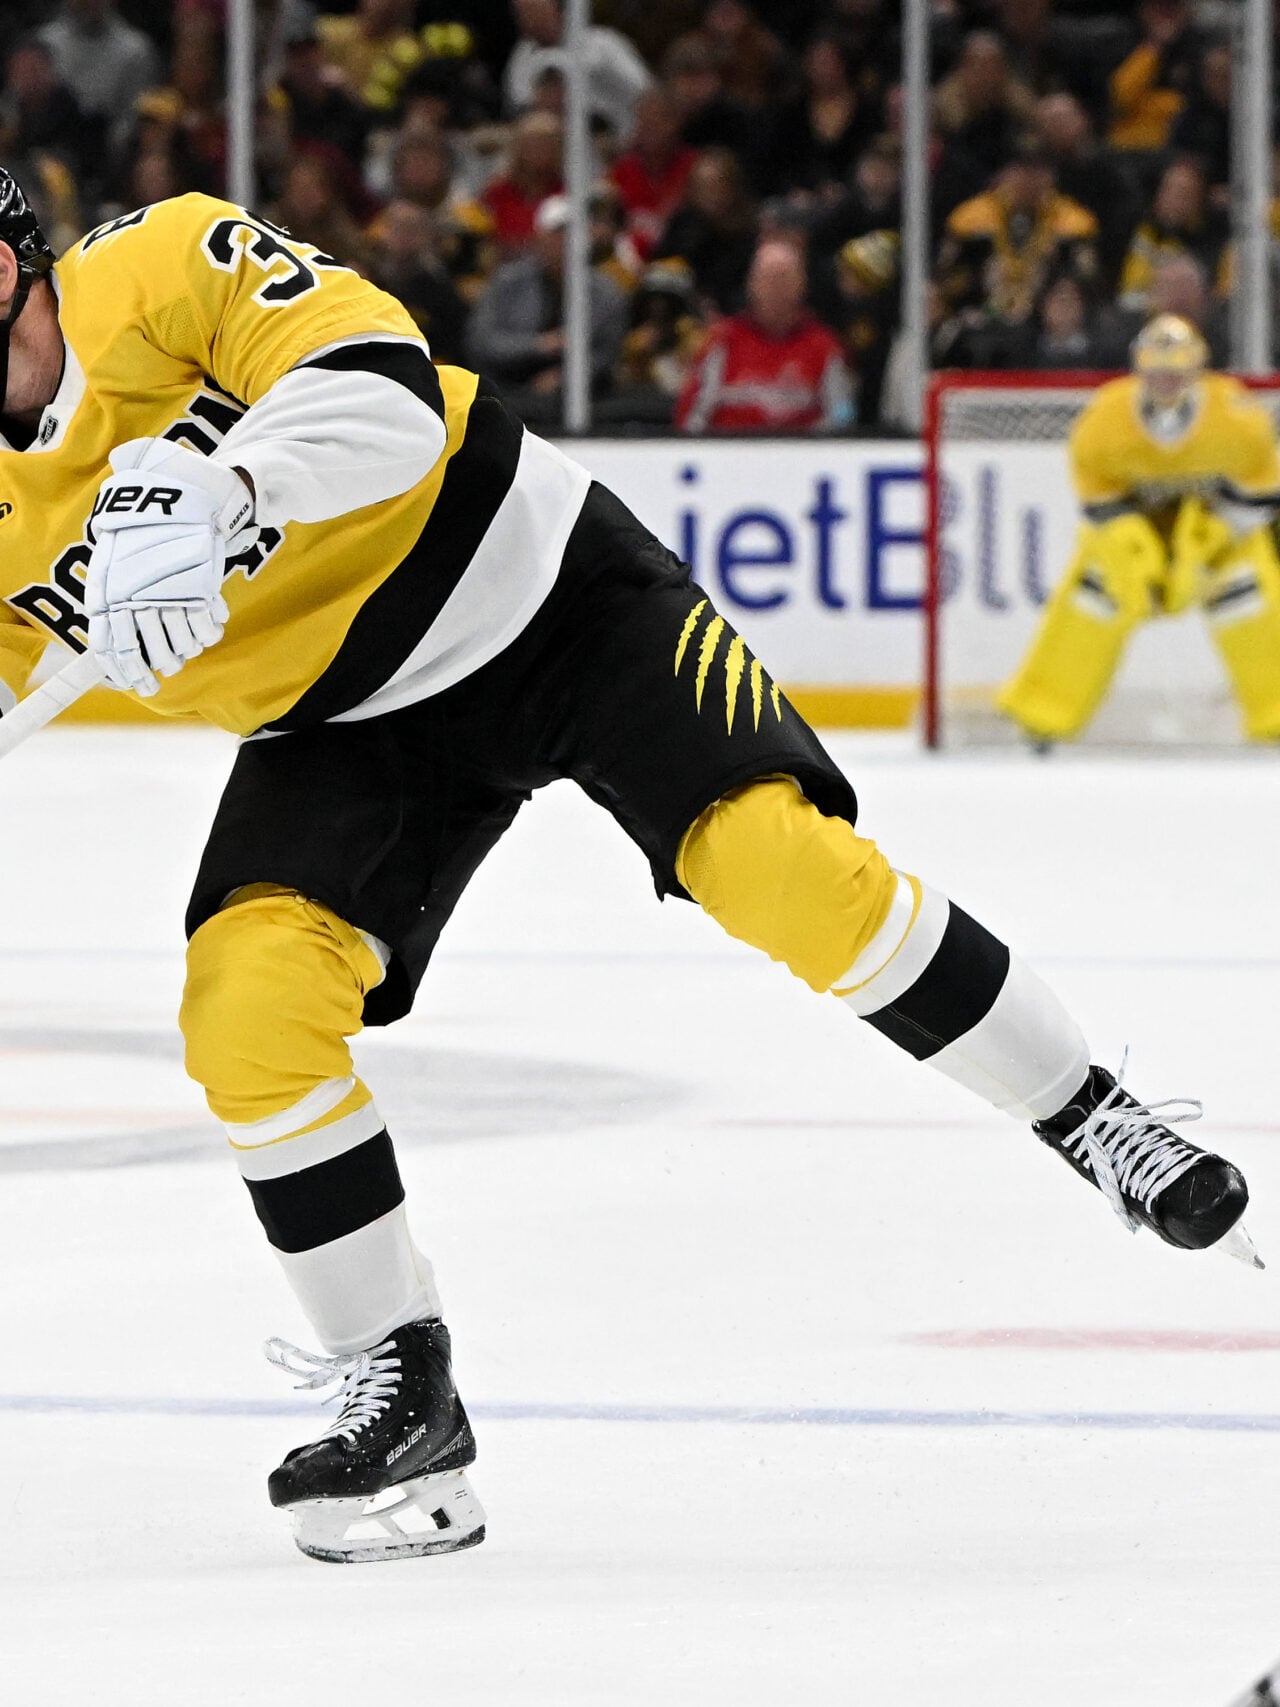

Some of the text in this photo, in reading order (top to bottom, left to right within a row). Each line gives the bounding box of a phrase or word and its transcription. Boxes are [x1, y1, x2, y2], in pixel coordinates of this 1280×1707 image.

[92, 486, 183, 515] UER
[676, 464, 1052, 610] jetBl
[385, 1423, 427, 1466] BAUER
